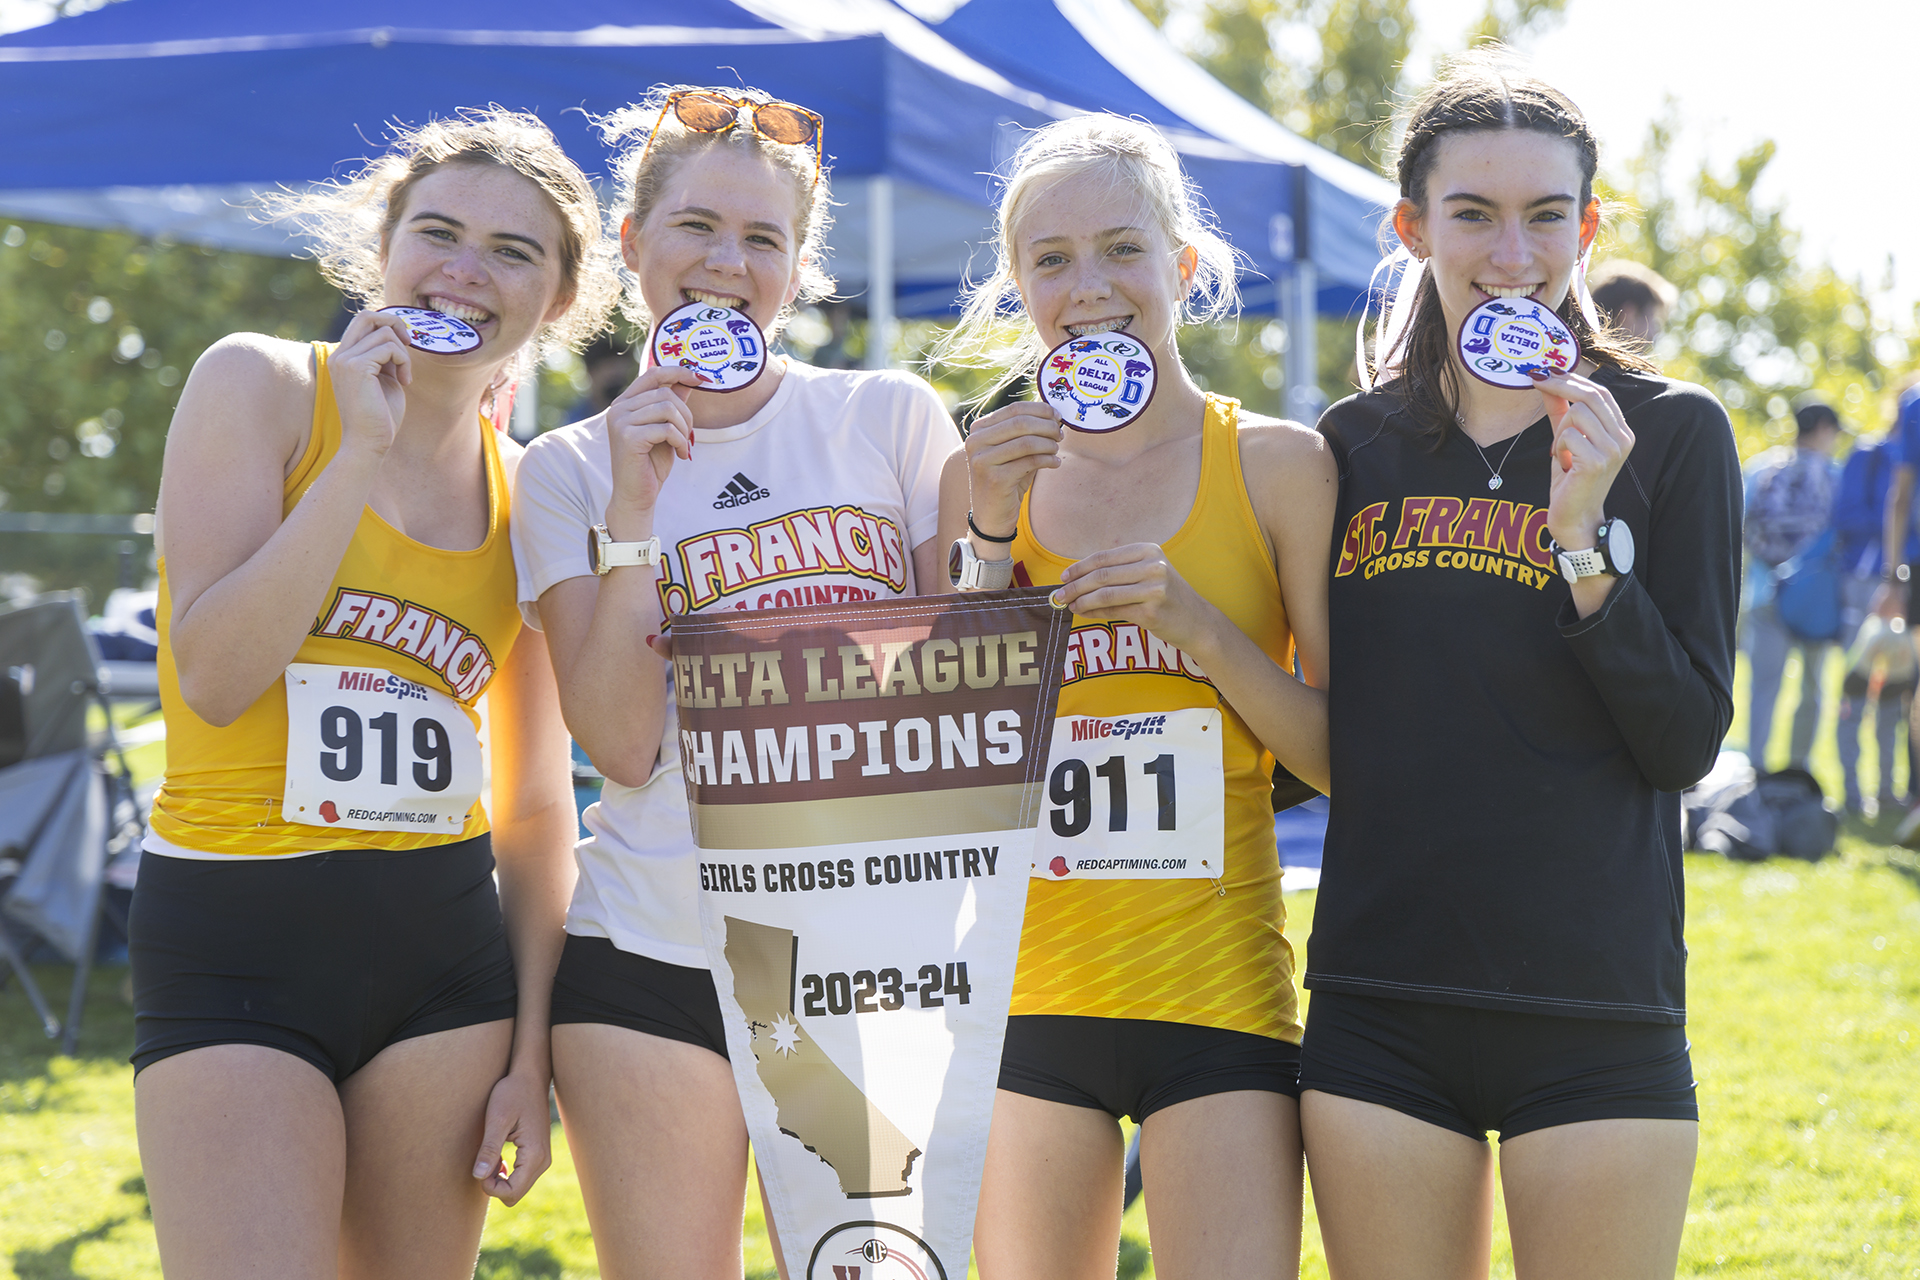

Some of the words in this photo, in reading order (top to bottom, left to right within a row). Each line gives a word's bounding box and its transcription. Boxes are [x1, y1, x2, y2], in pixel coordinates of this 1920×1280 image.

[1501, 332, 1540, 350] DELTA
[1508, 324, 1539, 338] LEAGUE
[690, 337, 729, 351] DELTA
[700, 349, 728, 359] LEAGUE
[1507, 347, 1523, 356] ALL
[1077, 366, 1116, 383] DELTA
[1093, 358, 1109, 366] ALL
[1078, 380, 1109, 393] LEAGUE
[712, 486, 771, 510] adidas
[1335, 501, 1389, 578] ST.
[1391, 496, 1558, 575] FRANC
[677, 505, 906, 611] FRANCIS
[1364, 550, 1431, 580] CROSS
[1435, 551, 1550, 591] COUNTRY
[314, 587, 496, 704] FRANCIS
[672, 650, 789, 709] ELTA
[802, 631, 1041, 702] LEAGUE
[337, 671, 429, 701] MileSplit
[1071, 715, 1167, 742] MileSplit
[319, 706, 453, 792] 919
[682, 709, 1024, 786] CHAMPIONS
[1049, 754, 1177, 837] 911
[346, 808, 438, 824] REDCAPTIMING.COM
[700, 863, 757, 893] GIRLS
[762, 858, 855, 893] CROSS
[864, 846, 1000, 886] COUNTRY
[1076, 858, 1188, 870] REDCAPTIMING.COM
[801, 962, 971, 1017] 2023-24
[863, 1239, 887, 1263] CIF
